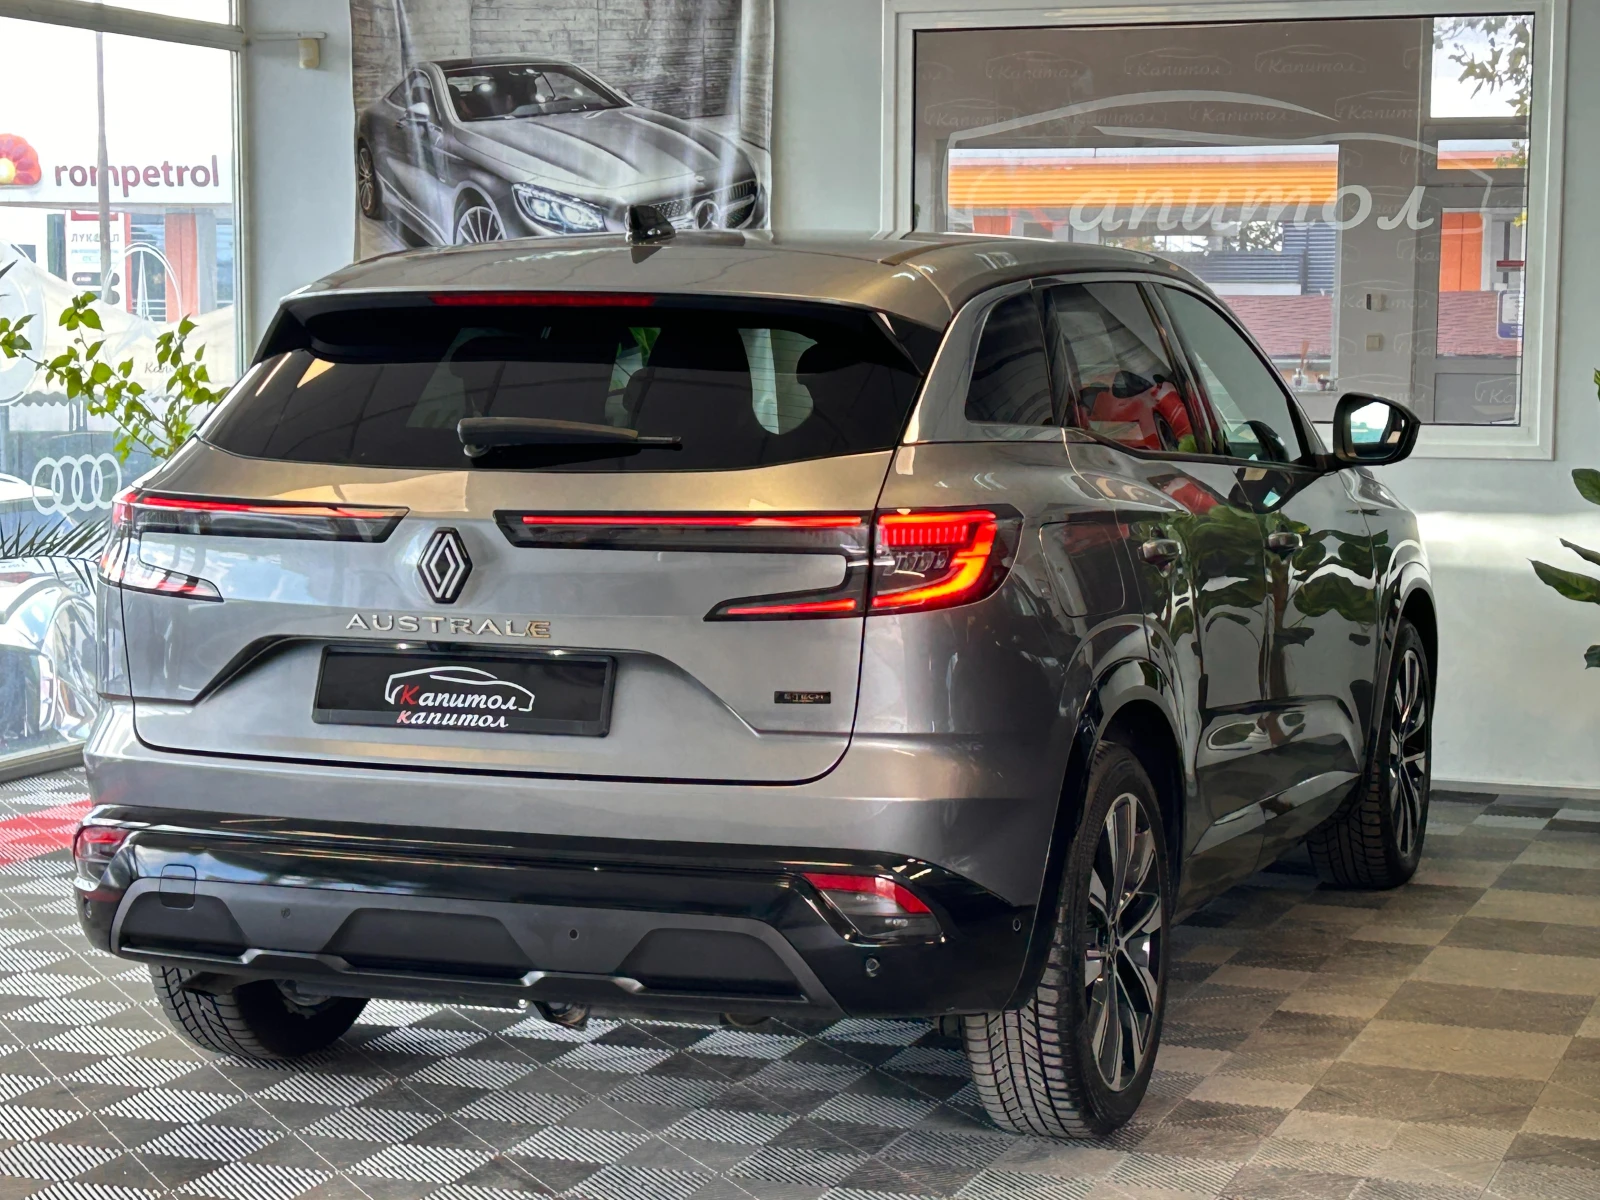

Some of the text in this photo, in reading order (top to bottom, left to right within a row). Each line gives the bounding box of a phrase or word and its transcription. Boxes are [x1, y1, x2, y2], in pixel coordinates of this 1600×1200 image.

[55, 155, 219, 198] rompetrol
[346, 613, 552, 639] AUSTRALE
[400, 684, 518, 711] Капитол
